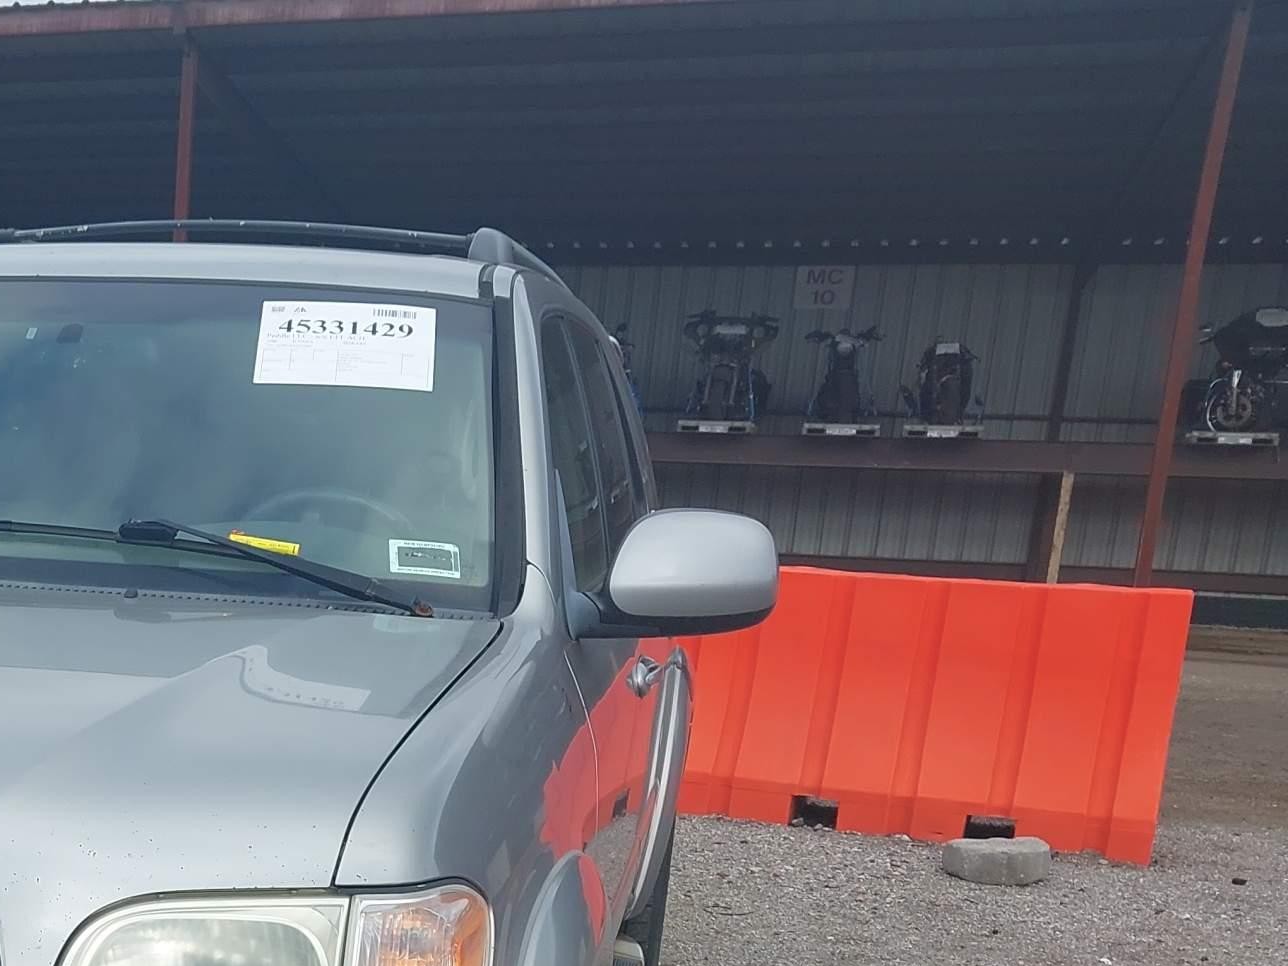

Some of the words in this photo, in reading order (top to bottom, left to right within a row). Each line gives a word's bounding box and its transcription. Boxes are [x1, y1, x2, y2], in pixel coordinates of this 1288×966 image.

[807, 270, 842, 285] MC
[811, 289, 835, 305] 10
[278, 318, 414, 339] 45331429
